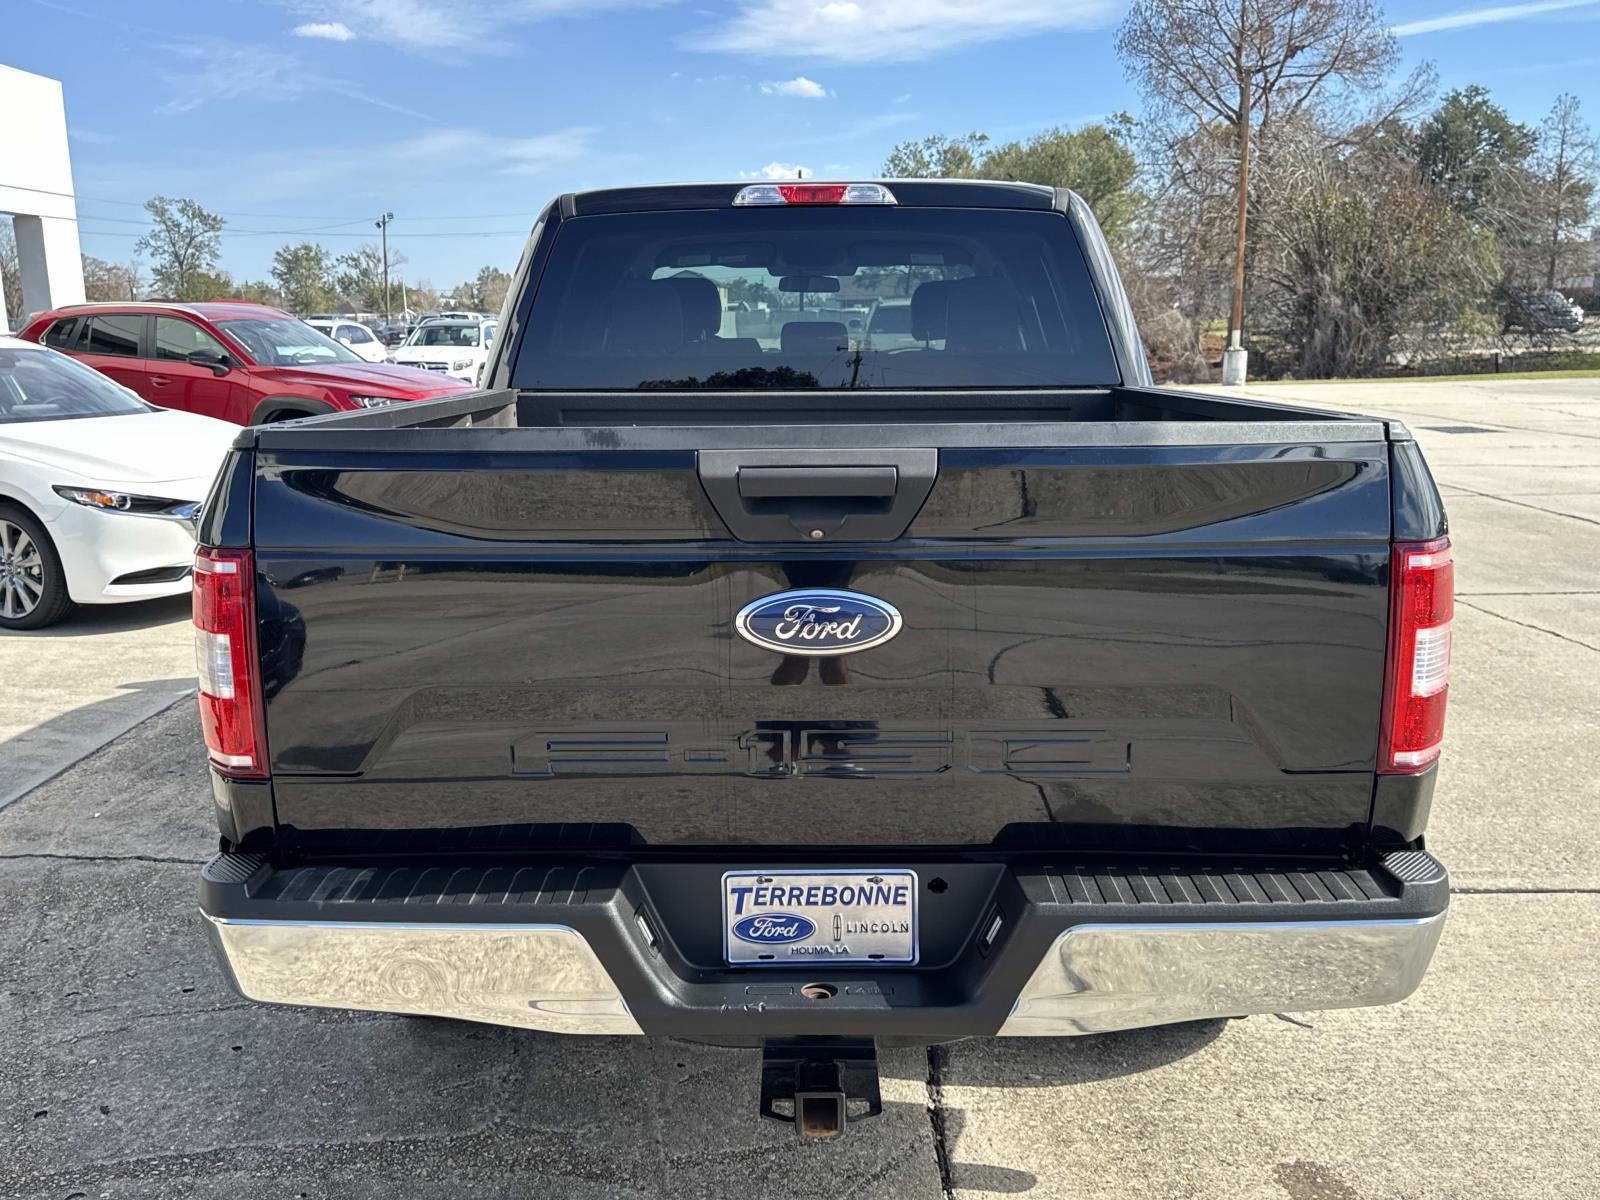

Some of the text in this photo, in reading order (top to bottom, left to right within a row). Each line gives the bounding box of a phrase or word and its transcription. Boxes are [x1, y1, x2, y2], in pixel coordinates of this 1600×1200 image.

[775, 604, 862, 640] Ford
[511, 729, 1132, 778] F-150
[730, 885, 909, 915] TERREBONNE
[749, 917, 799, 937] Ford
[846, 922, 910, 934] LINCOLN
[836, 946, 849, 955] LA
